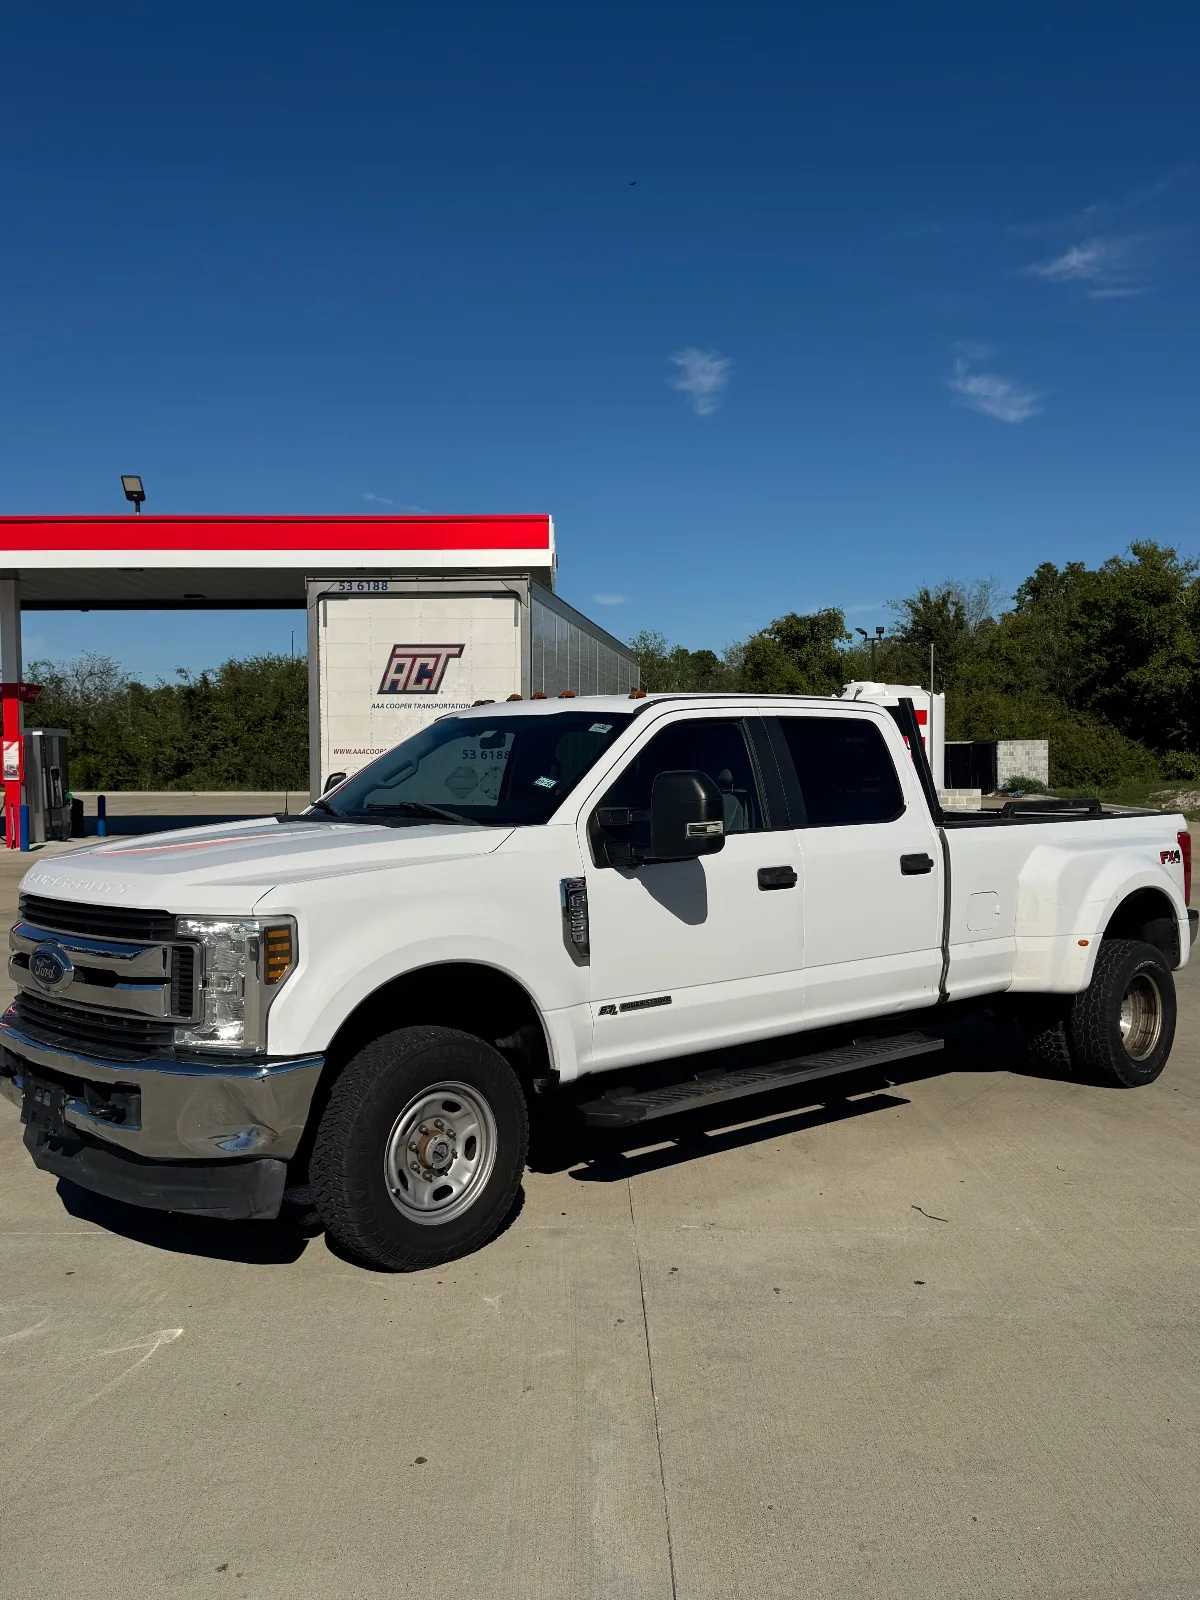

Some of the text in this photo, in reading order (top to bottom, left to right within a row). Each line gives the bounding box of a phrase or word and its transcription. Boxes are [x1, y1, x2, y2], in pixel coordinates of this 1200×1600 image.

[339, 581, 388, 591] 53 6188
[377, 643, 466, 695] ACT
[461, 749, 510, 760] 53 6188
[1160, 850, 1181, 864] FX4
[34, 957, 56, 979] Ford
